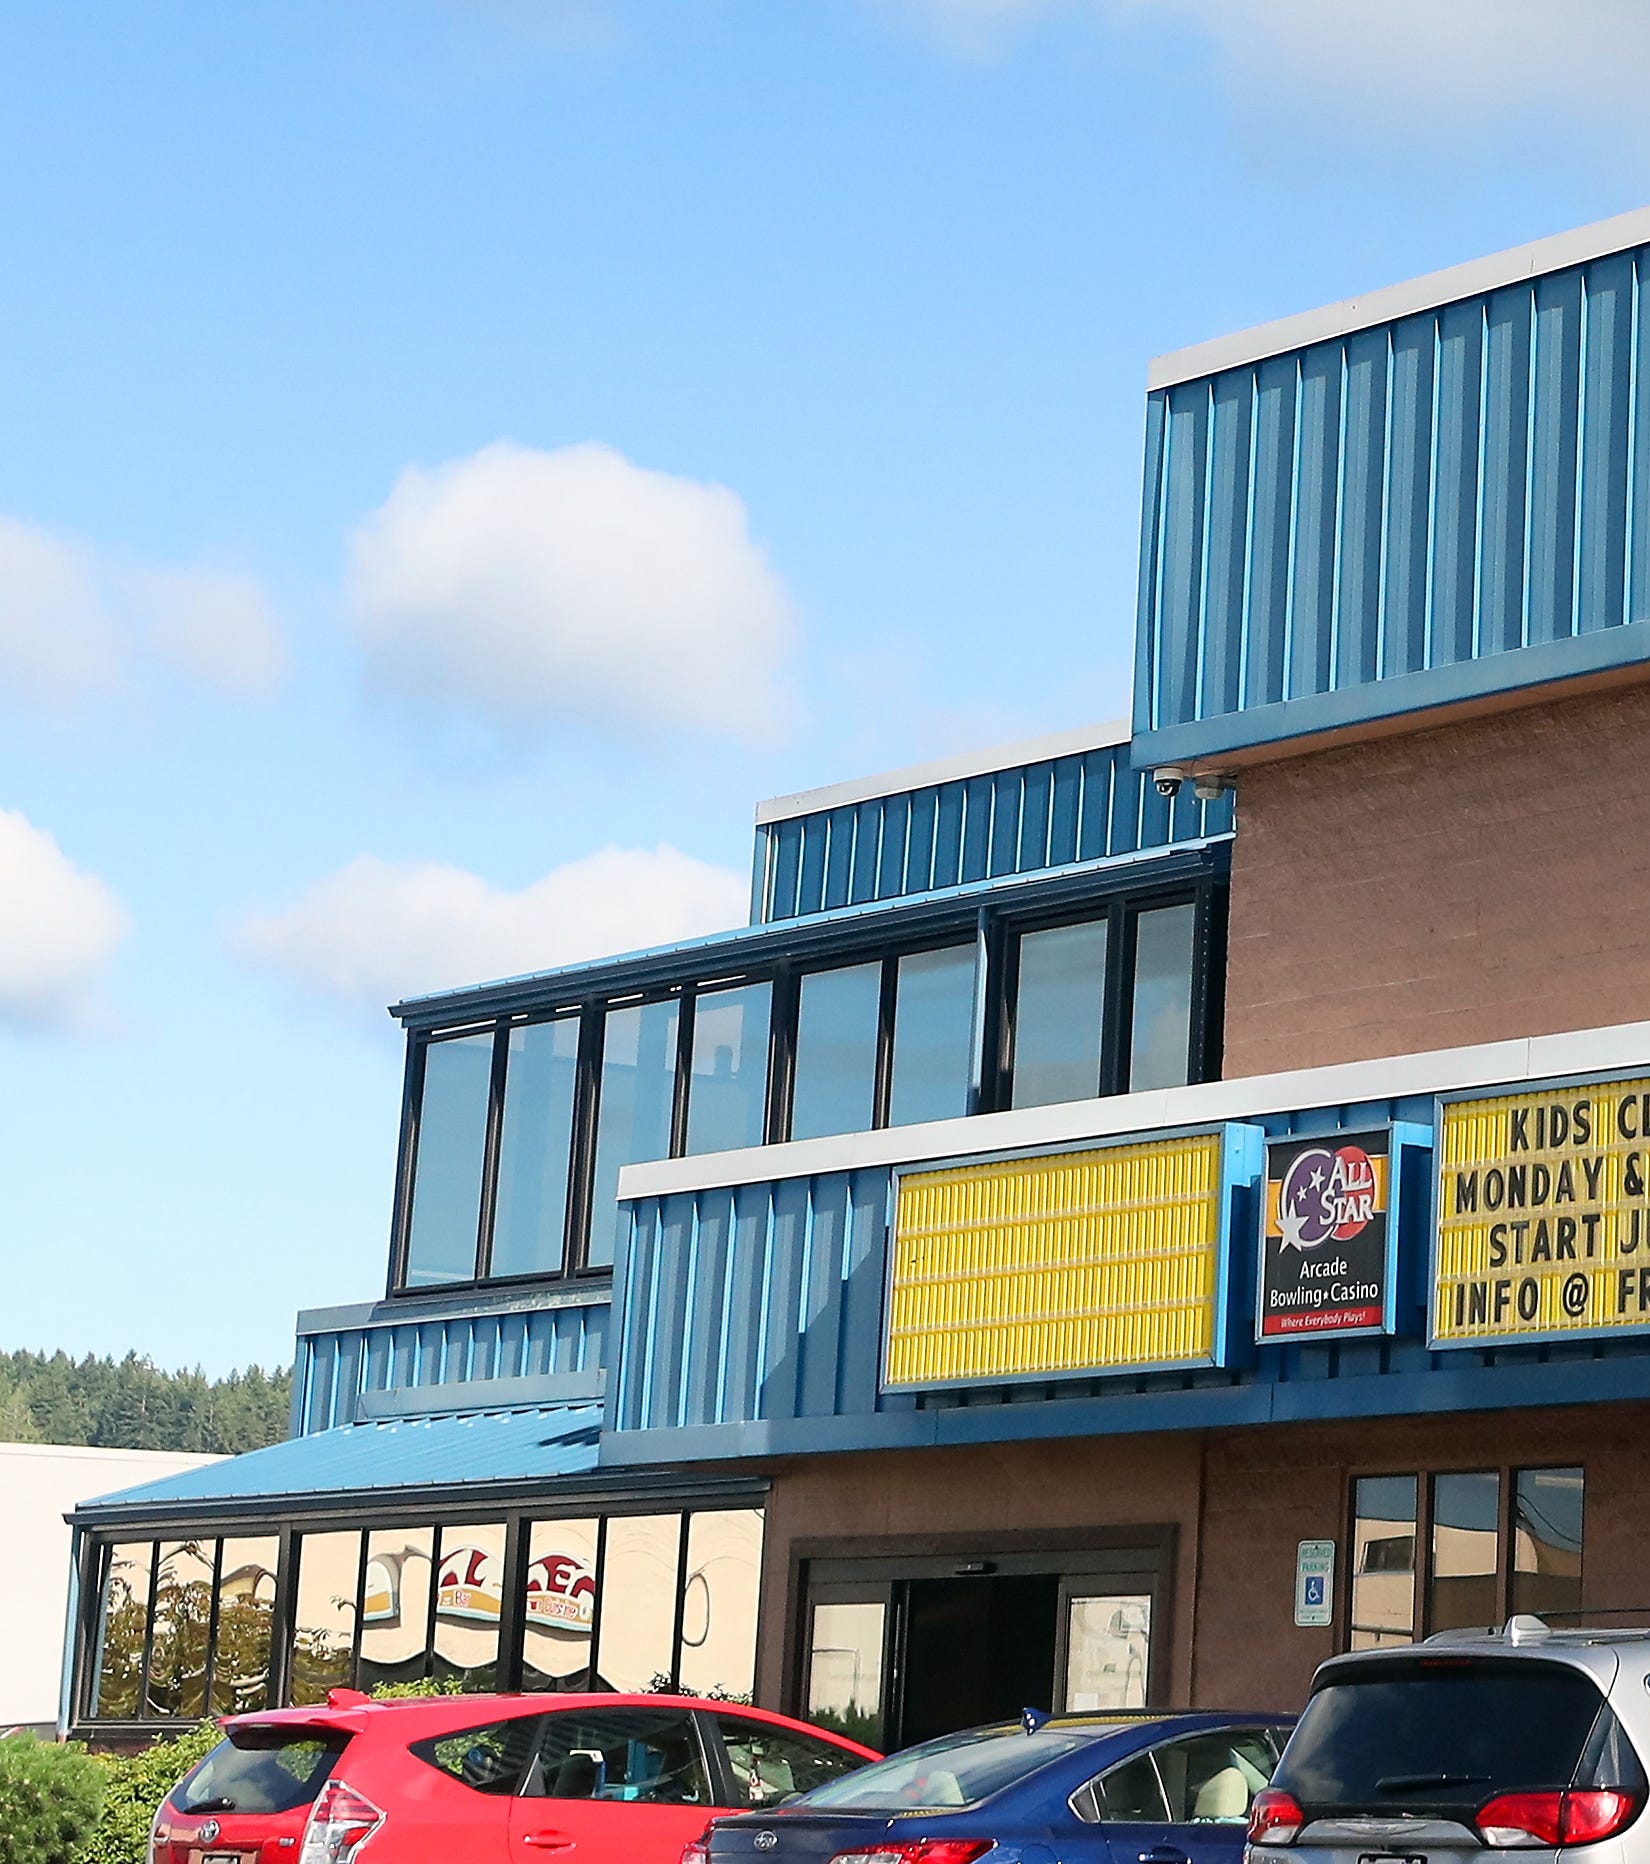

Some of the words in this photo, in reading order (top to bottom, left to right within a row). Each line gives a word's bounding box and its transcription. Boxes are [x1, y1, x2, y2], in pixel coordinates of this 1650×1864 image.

[1510, 1100, 1591, 1151] KIDS
[1456, 1157, 1604, 1214] MONDAY
[1624, 1152, 1644, 1197] &
[1488, 1212, 1601, 1268] START
[1300, 1256, 1348, 1279] Arcade
[1281, 1317, 1304, 1328] Where
[1304, 1312, 1342, 1327] Everybody
[1343, 1310, 1366, 1324] Plays!
[1455, 1278, 1538, 1327] INFO
[1562, 1272, 1588, 1318] @
